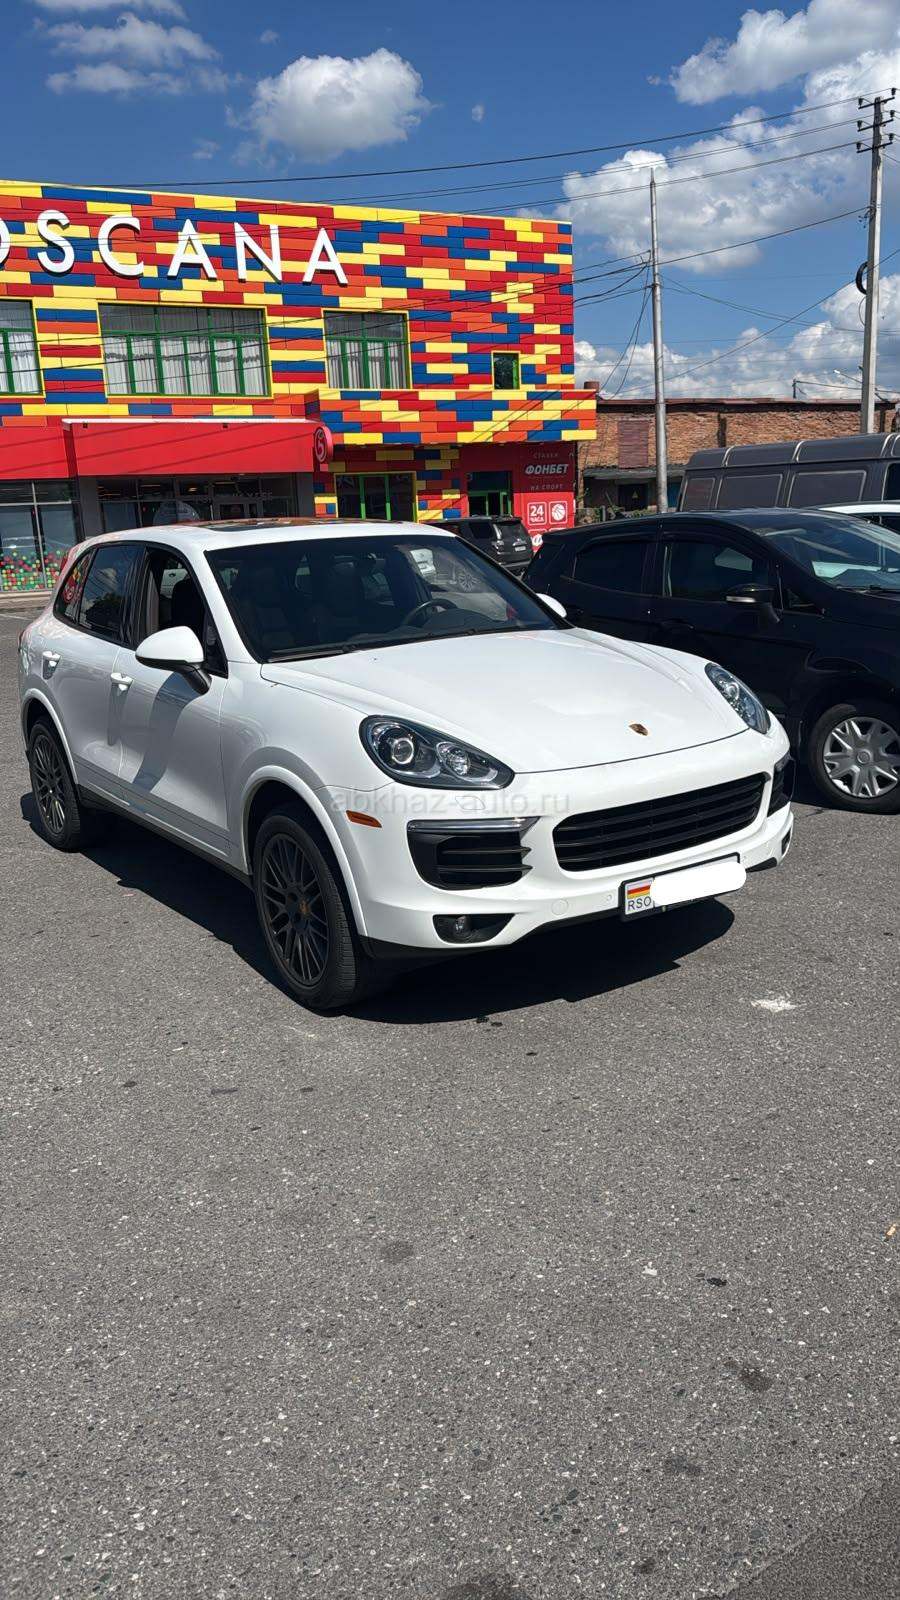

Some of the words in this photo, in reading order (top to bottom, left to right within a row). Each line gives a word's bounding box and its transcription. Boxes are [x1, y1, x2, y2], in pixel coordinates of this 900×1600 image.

[0, 209, 348, 285] SCANA
[525, 463, 569, 475] ФОНБЕТ
[530, 505, 544, 516] 24
[628, 896, 651, 911] RSO
